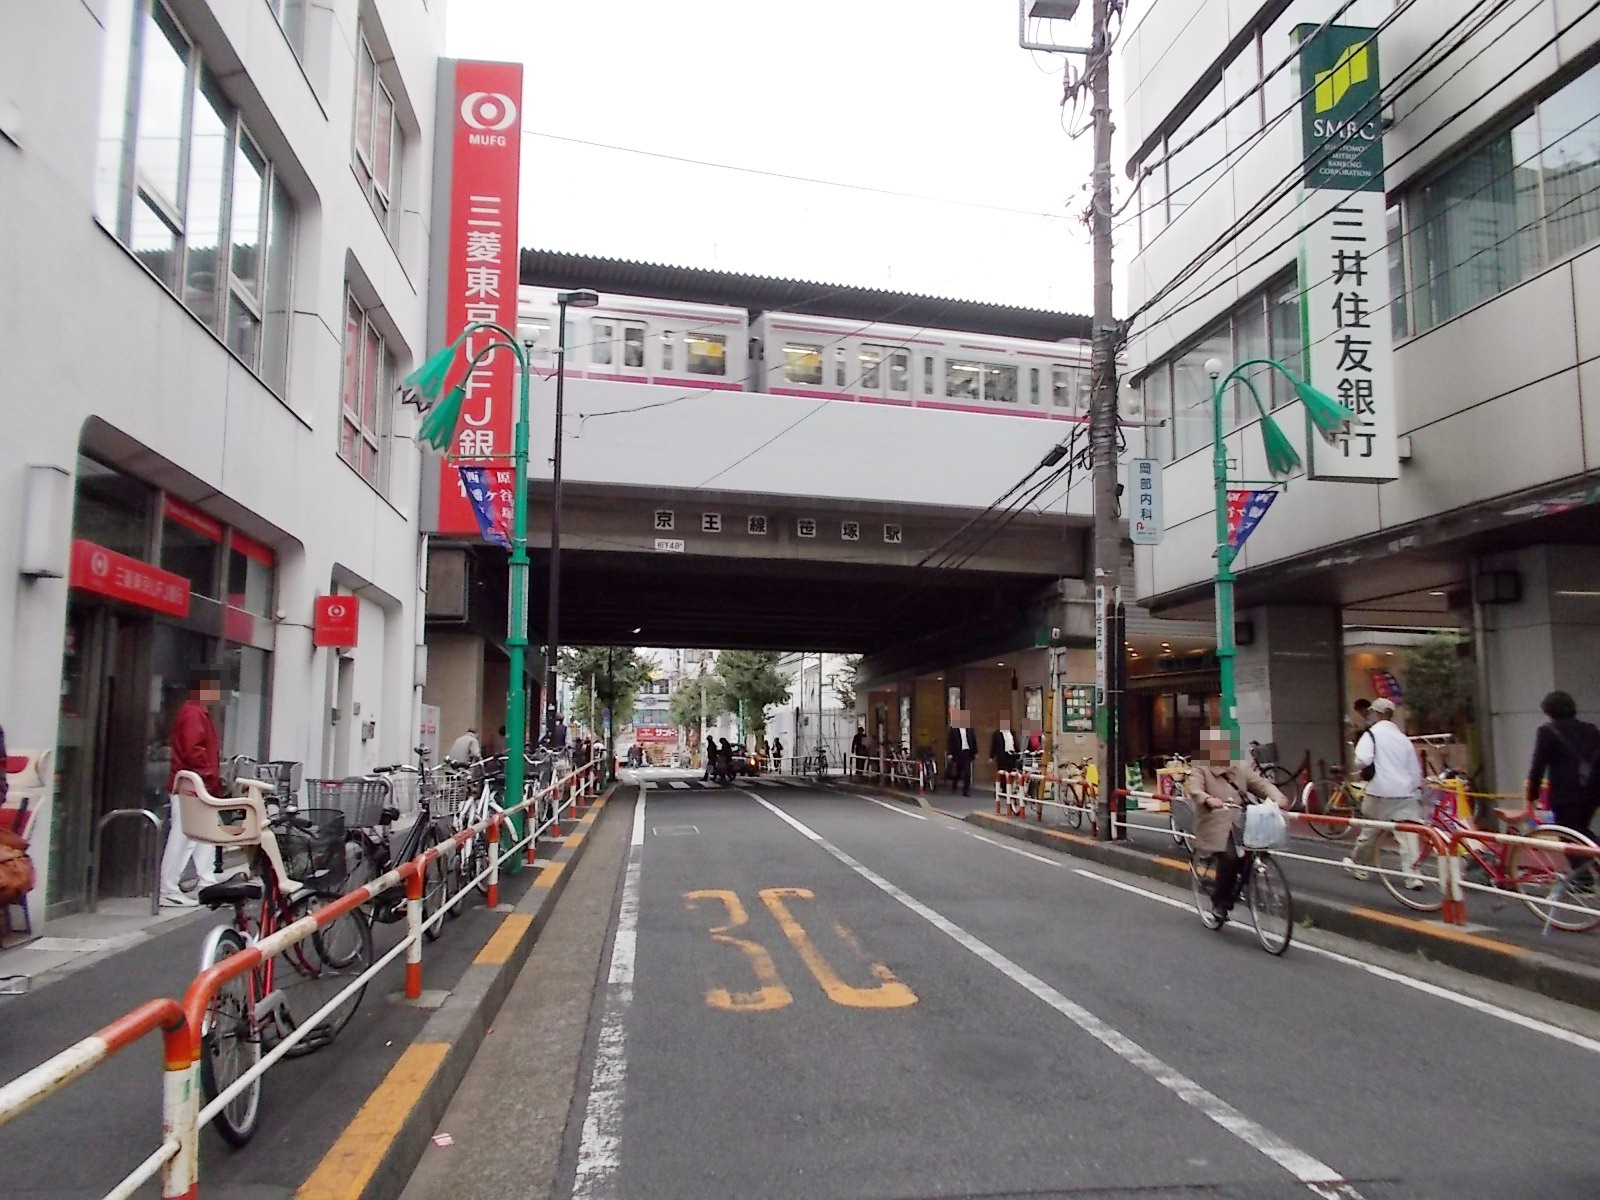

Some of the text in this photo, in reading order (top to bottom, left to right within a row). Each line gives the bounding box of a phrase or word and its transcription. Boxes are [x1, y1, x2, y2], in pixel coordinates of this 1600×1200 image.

[468, 134, 507, 147] MUFG
[1313, 119, 1375, 140] SMBC
[1319, 168, 1372, 177] CORPORATION
[457, 195, 502, 498] 三菱東京UFJ銀
[1330, 207, 1377, 458] 三井住友銀行
[683, 887, 919, 1011] 30
